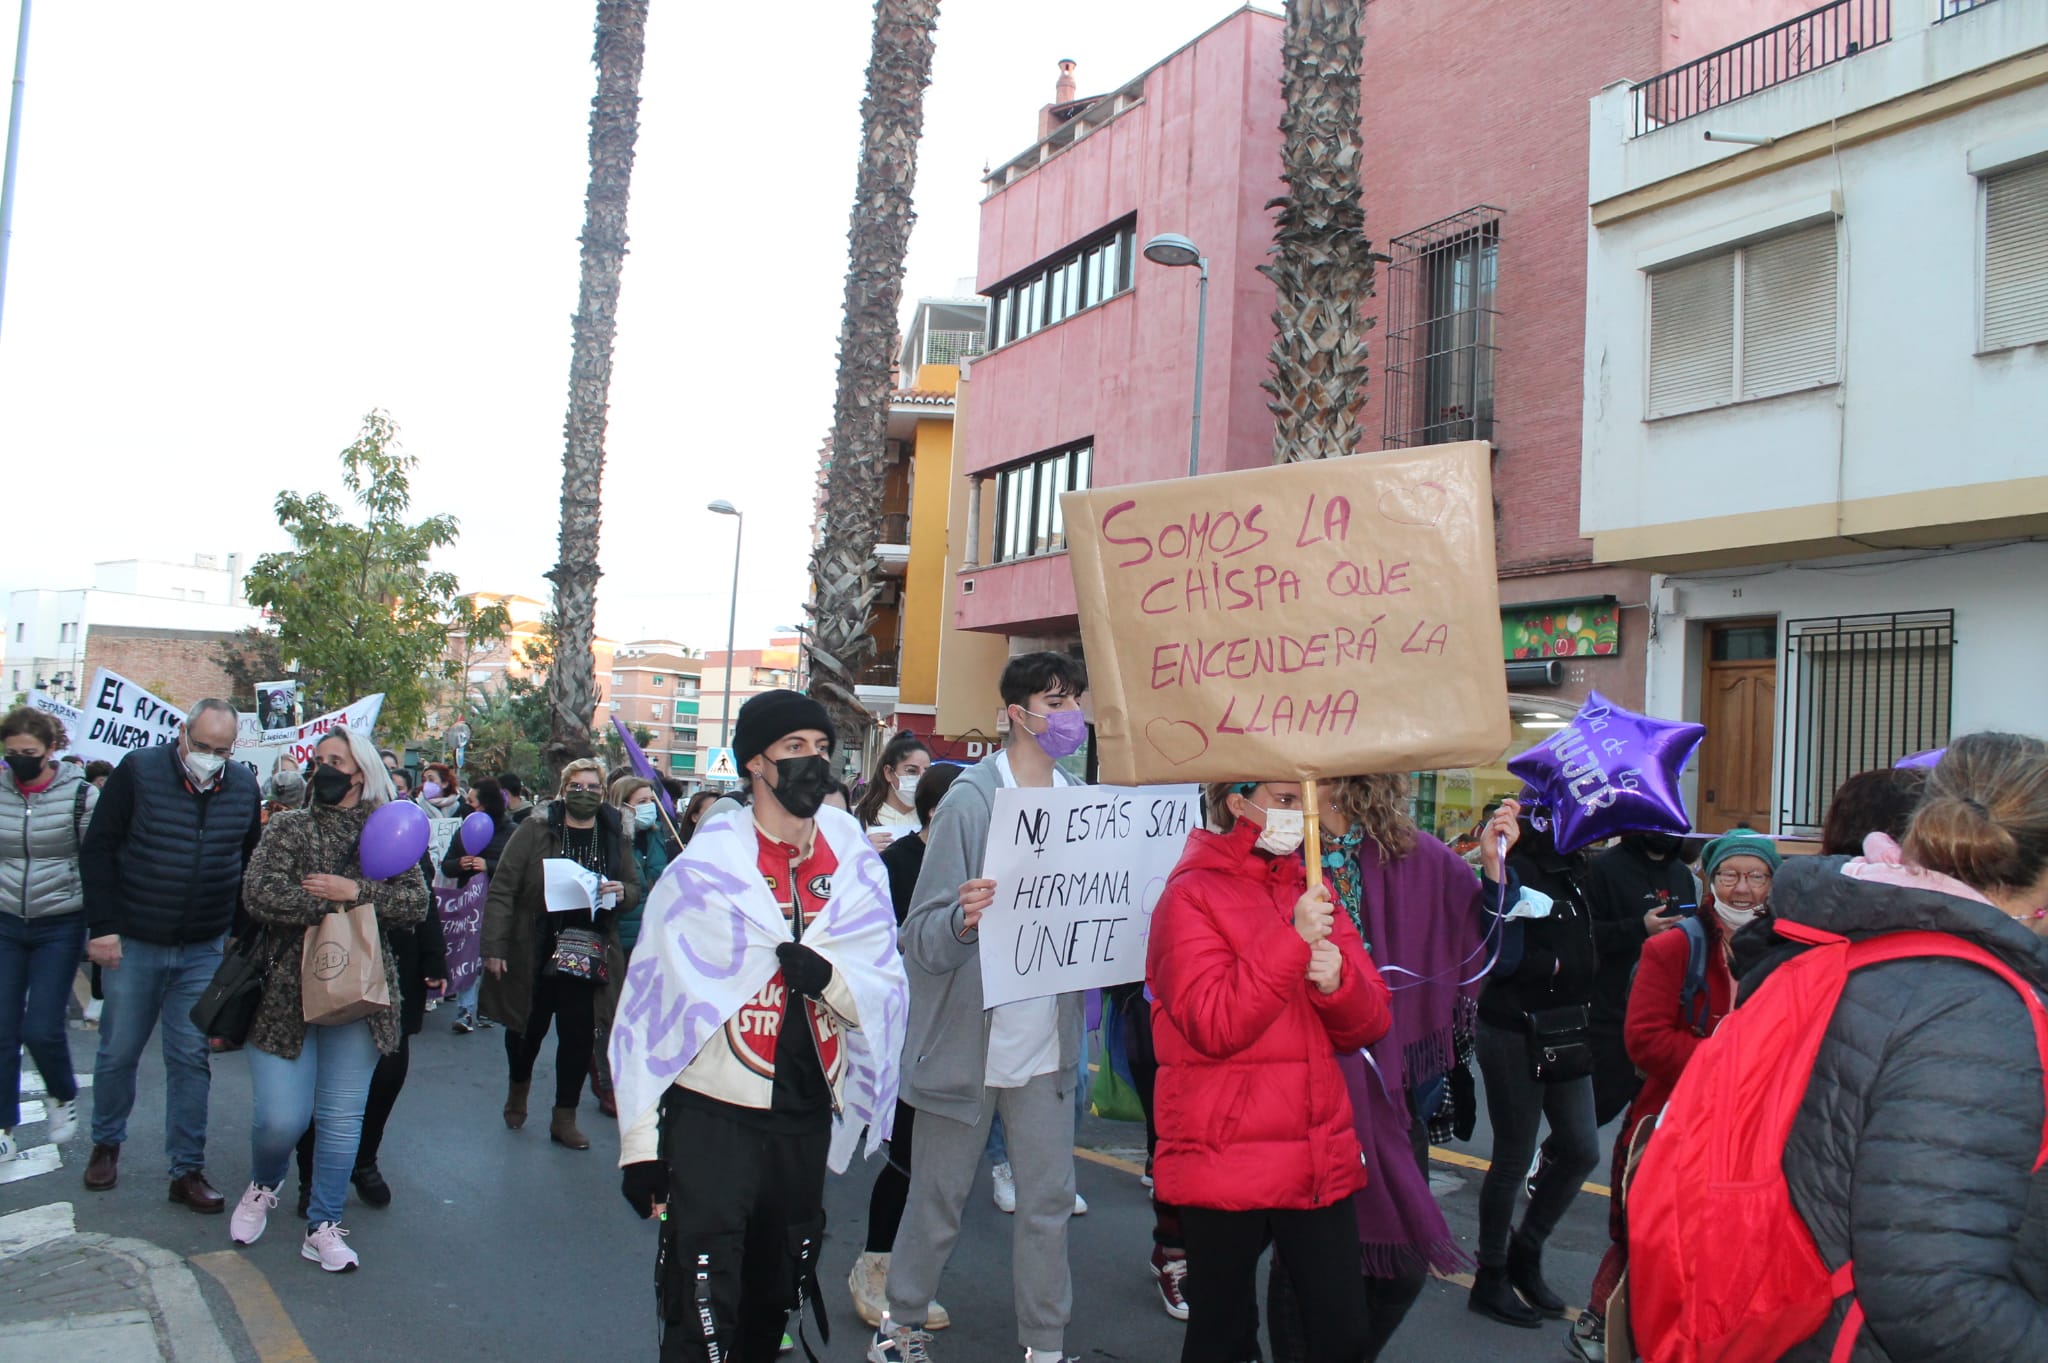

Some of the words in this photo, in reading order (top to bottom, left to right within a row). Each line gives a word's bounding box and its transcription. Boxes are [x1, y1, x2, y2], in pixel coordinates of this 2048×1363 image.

[1102, 499, 1268, 568] SOMOS
[1295, 493, 1351, 549] LA
[1327, 559, 1410, 598] QUE
[1151, 614, 1387, 690] ENCENDERÁ
[1400, 620, 1448, 656] LA
[96, 677, 124, 714] EL
[1216, 689, 1360, 736] LLAMA
[1542, 727, 1617, 816] MUJER
[1066, 794, 1132, 843] ESTÁS
[1146, 799, 1187, 838] SOLA
[1015, 918, 1128, 976] ÚNETE
